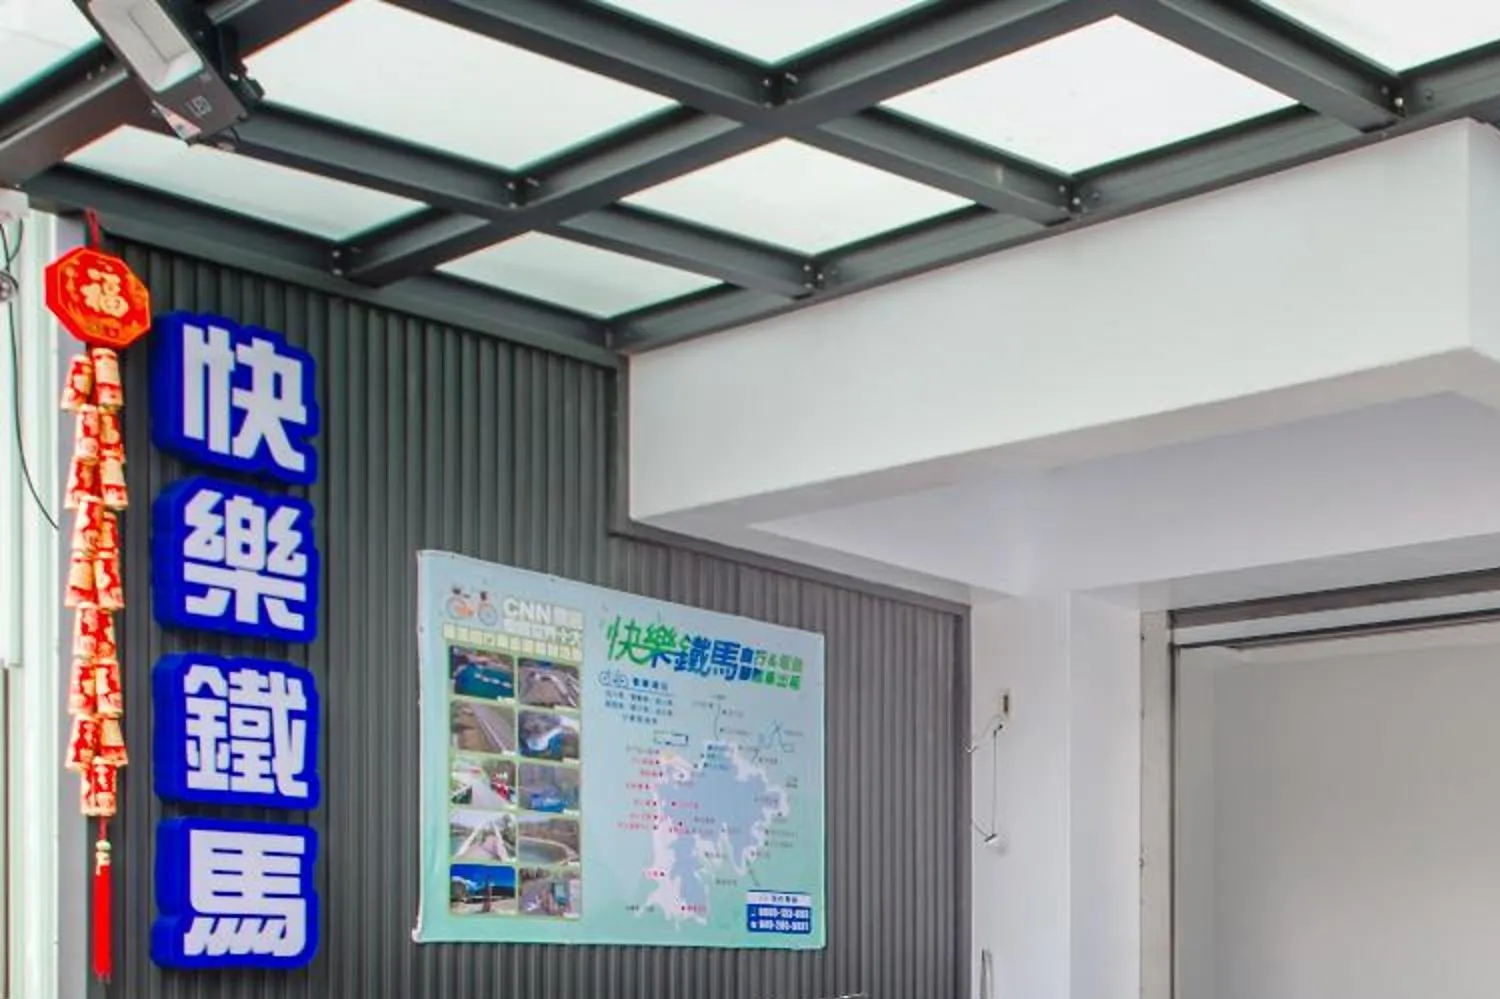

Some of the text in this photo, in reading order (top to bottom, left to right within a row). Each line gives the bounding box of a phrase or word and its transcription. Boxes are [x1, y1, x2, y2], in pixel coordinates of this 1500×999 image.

[183, 324, 308, 958] 快樂鐵馬
[503, 599, 551, 625] CNN
